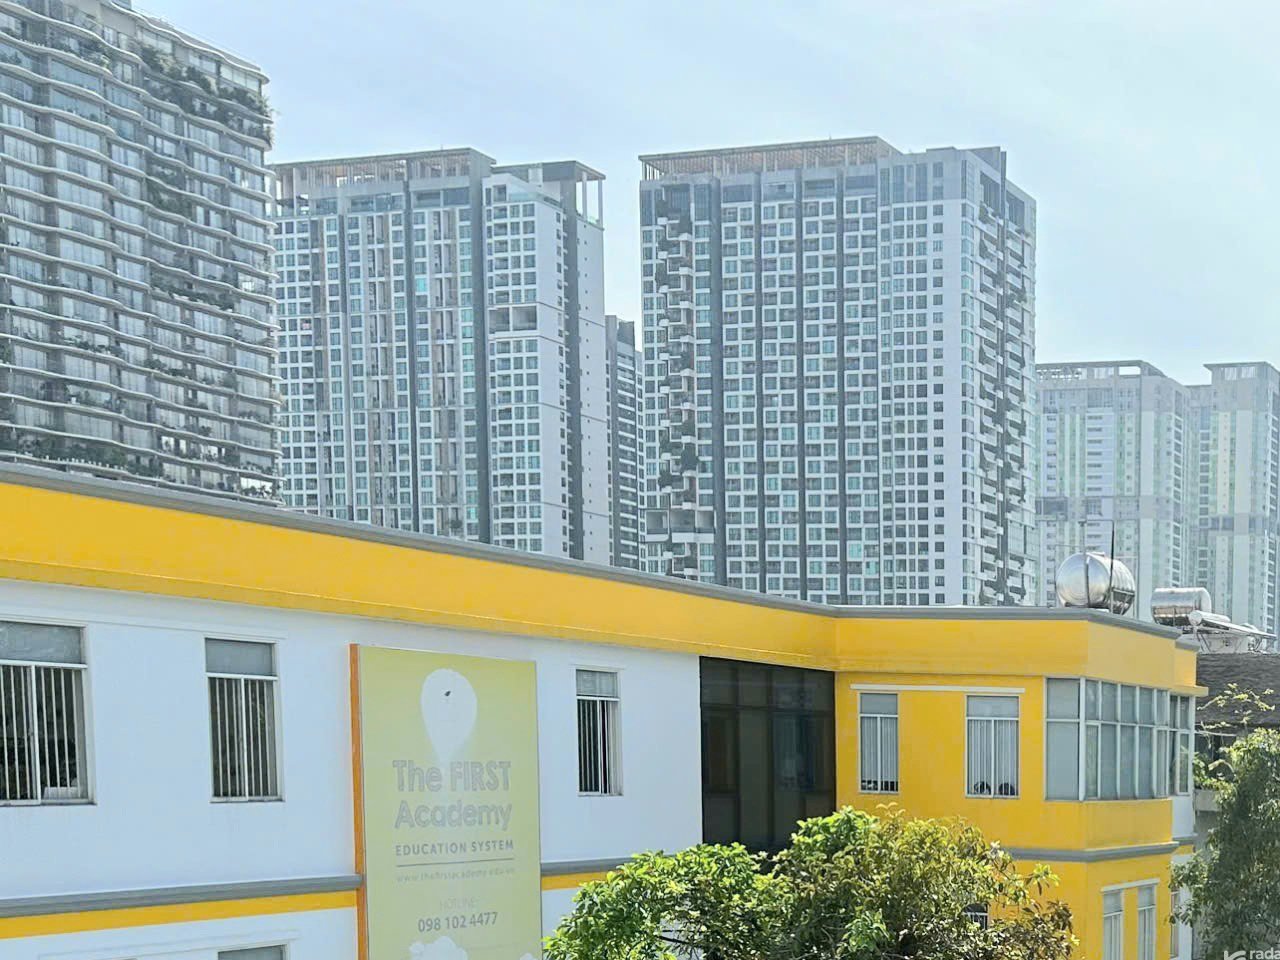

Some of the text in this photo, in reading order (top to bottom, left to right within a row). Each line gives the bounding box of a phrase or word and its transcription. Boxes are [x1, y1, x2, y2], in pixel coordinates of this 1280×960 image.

[392, 760, 511, 792] The FIRST
[394, 799, 512, 831] Academy
[395, 839, 514, 856] EDUCATION SYSTEM
[417, 911, 498, 933] 098 102 4477
